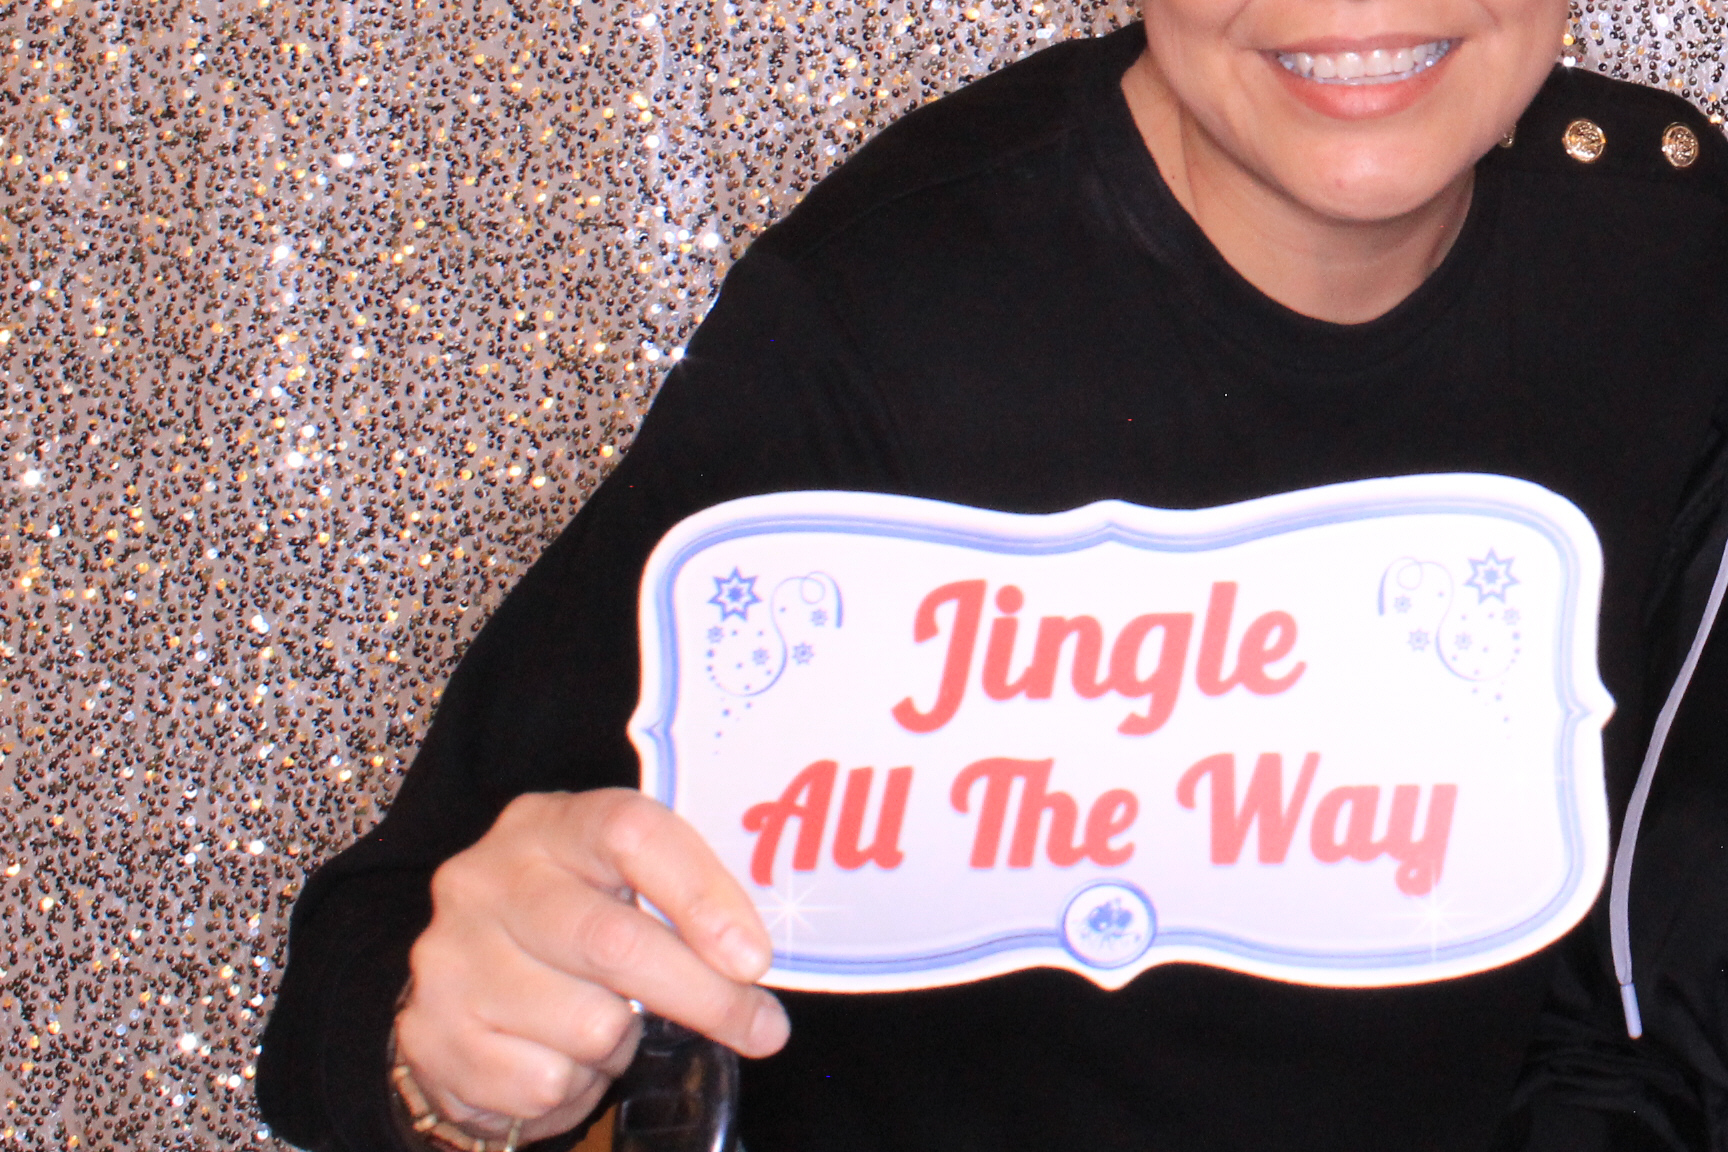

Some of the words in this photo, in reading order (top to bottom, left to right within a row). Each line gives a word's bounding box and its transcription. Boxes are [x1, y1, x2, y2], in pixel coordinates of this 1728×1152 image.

[890, 579, 1306, 735] Jingle
[741, 758, 914, 886] All
[950, 757, 1140, 869] The
[1176, 751, 1459, 895] Way
